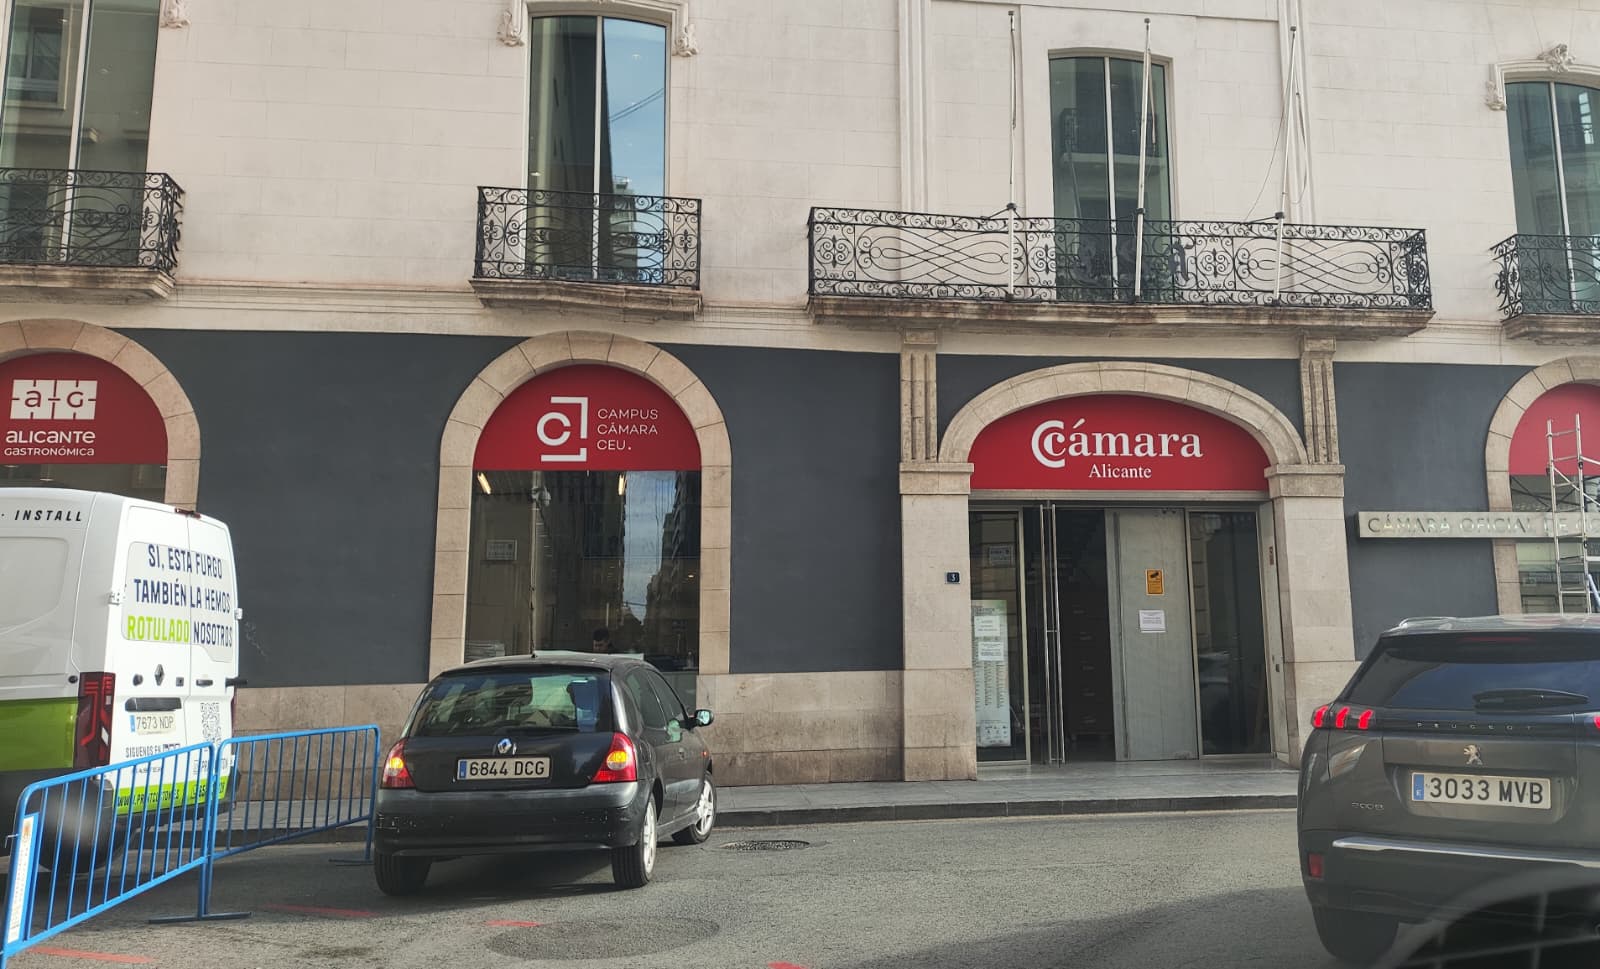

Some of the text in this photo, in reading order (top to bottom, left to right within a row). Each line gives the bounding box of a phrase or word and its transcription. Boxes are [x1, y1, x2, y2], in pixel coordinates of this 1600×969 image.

[597, 408, 658, 420] CAMPUS
[597, 422, 658, 435] CÁMARA
[596, 439, 632, 451] CEU.
[1088, 463, 1152, 479] Alicante
[15, 510, 81, 521] INSTALL
[1367, 514, 1451, 534] CÁMARA
[1459, 517, 1535, 534] OFICIAL
[168, 547, 192, 573] ESTA
[195, 553, 222, 579] FURGO
[133, 578, 231, 614] TAMBIÉN LA HEMOS
[127, 615, 233, 648] ROTULADO NOSOTROS
[469, 761, 545, 776] 6844 DCG
[1430, 777, 1490, 800] 3033
[1499, 780, 1543, 804] MVB
